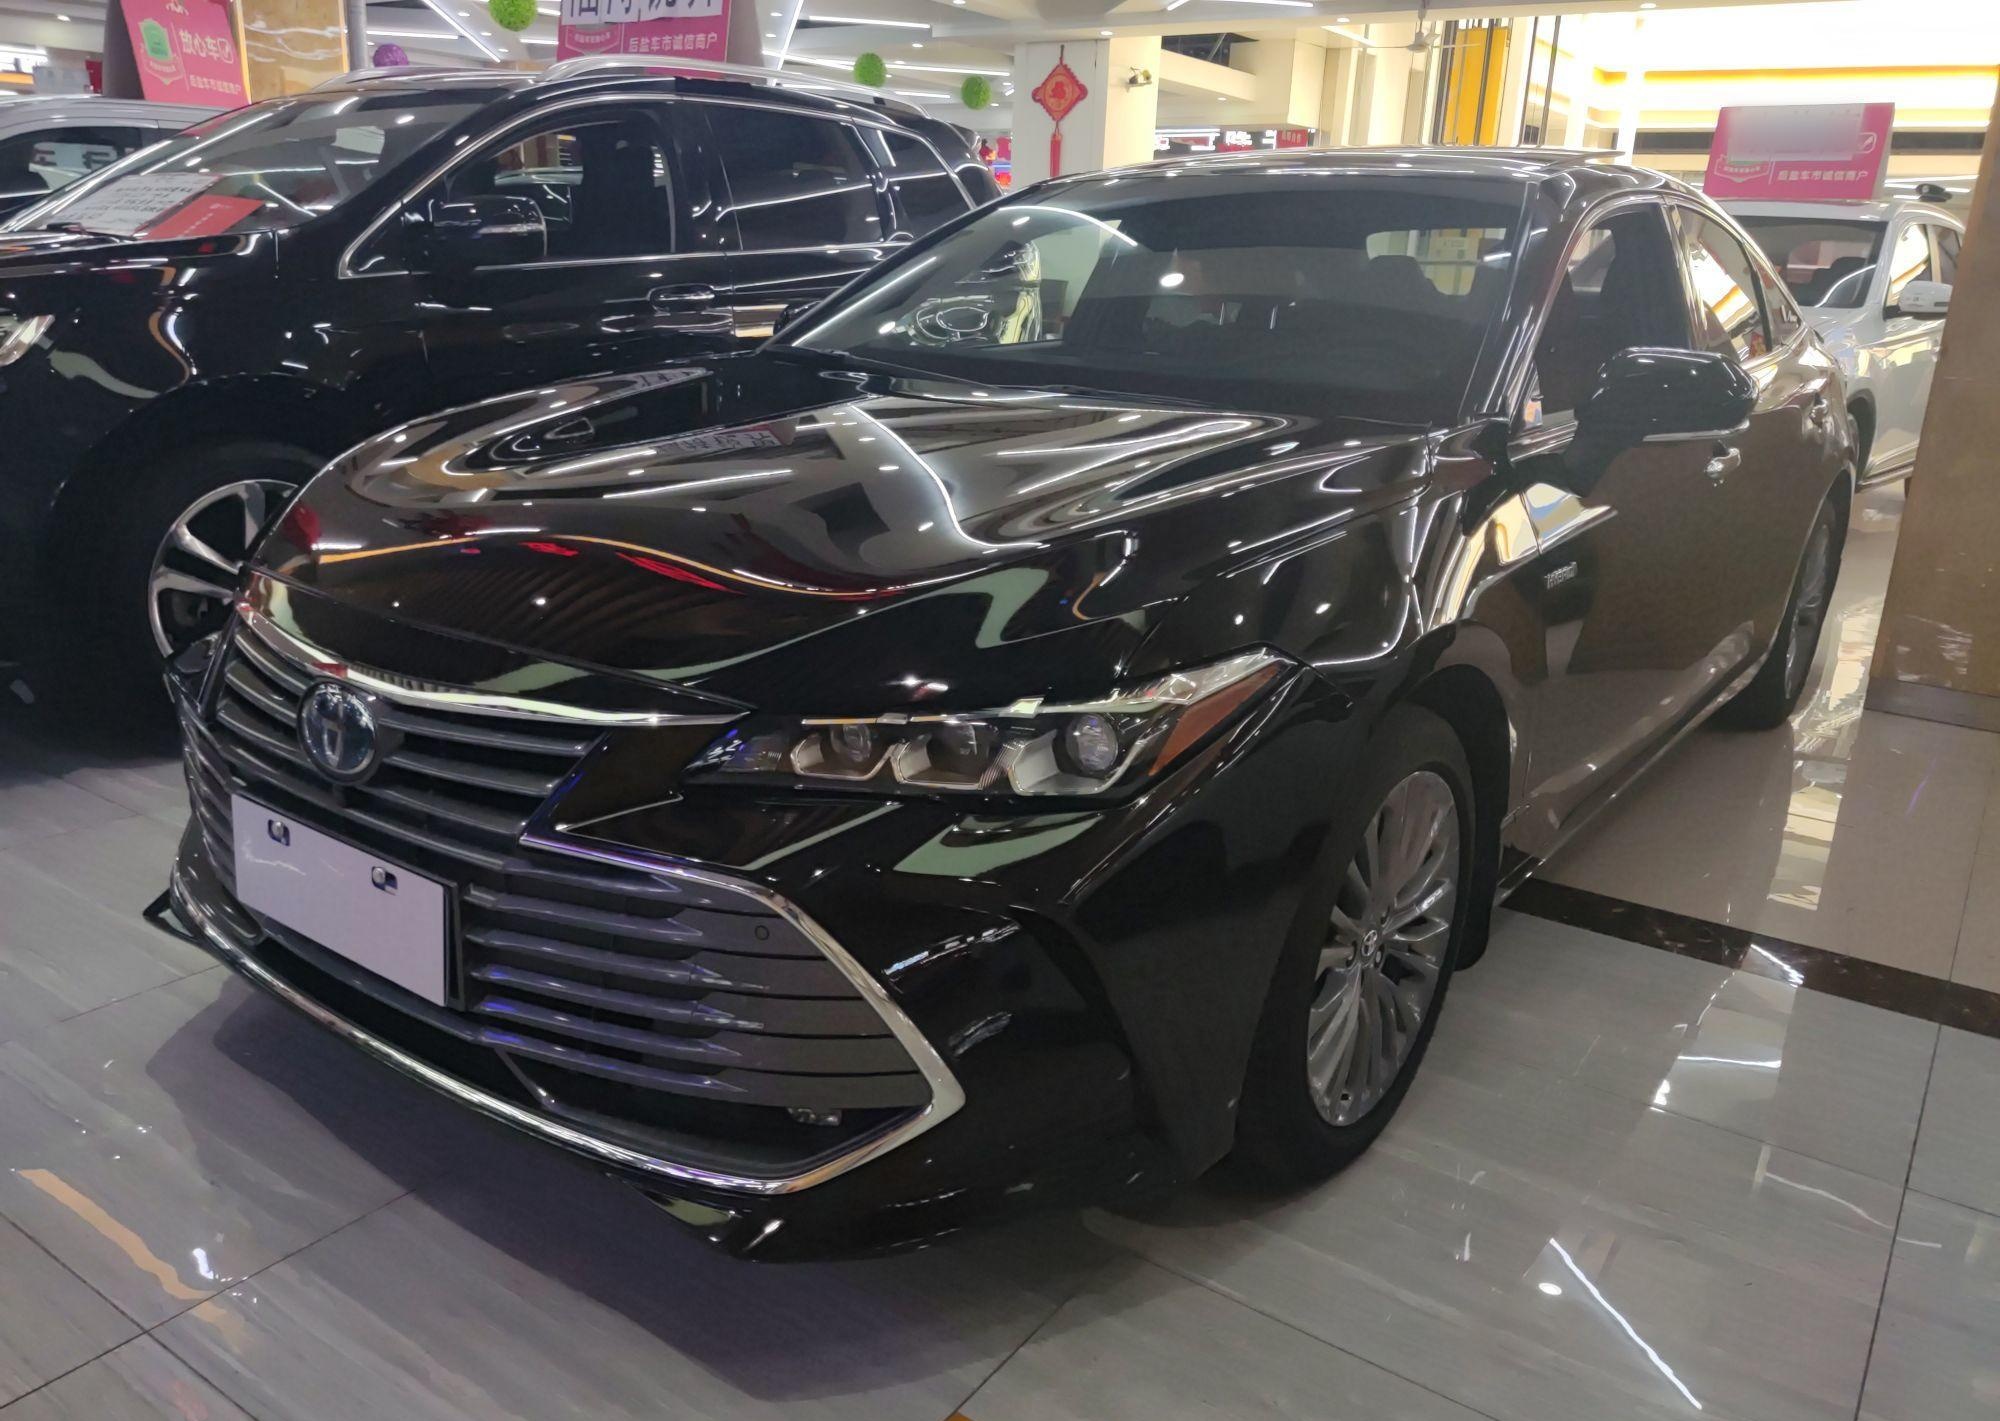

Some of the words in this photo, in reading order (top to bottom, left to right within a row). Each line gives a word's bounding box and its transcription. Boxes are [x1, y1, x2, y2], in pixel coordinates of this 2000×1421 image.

[628, 32, 718, 53] 后盐车市诚信商户
